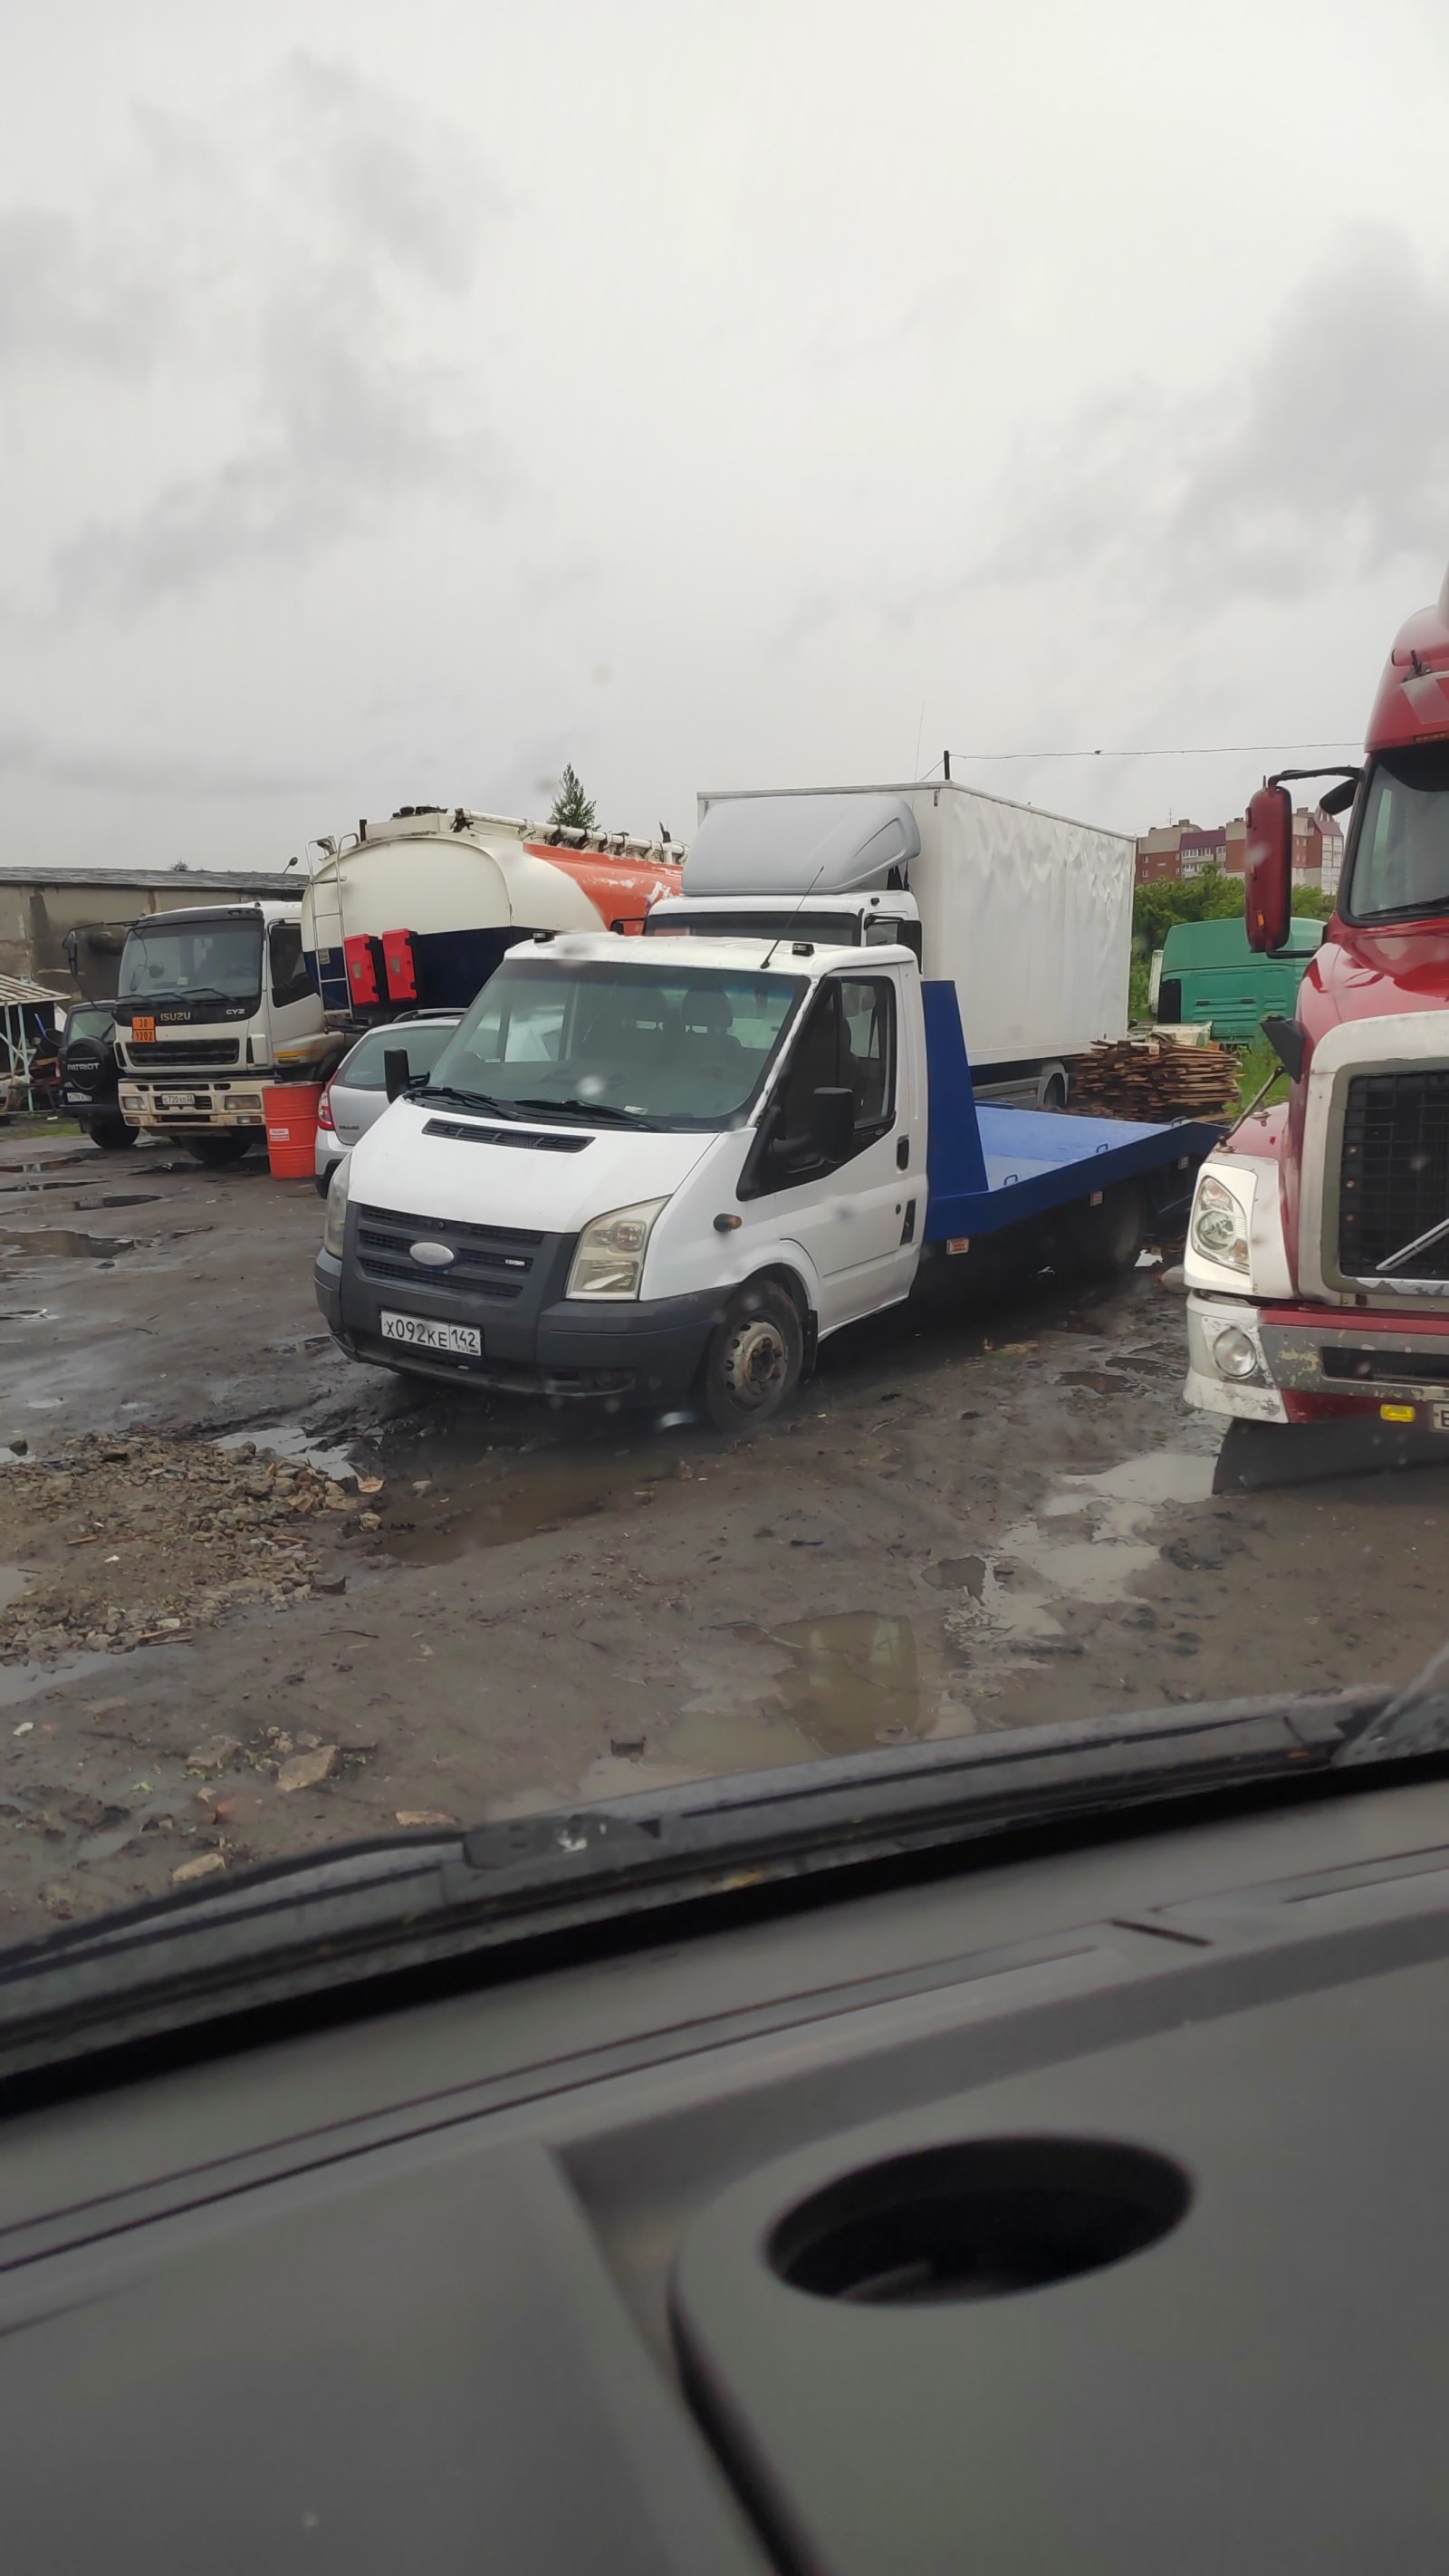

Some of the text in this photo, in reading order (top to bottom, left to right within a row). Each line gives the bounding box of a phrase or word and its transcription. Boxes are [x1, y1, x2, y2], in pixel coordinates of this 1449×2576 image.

[160, 1012, 191, 1021] ISUZU
[136, 1032, 153, 1041] 1202
[67, 1062, 101, 1072] PATRIOT
